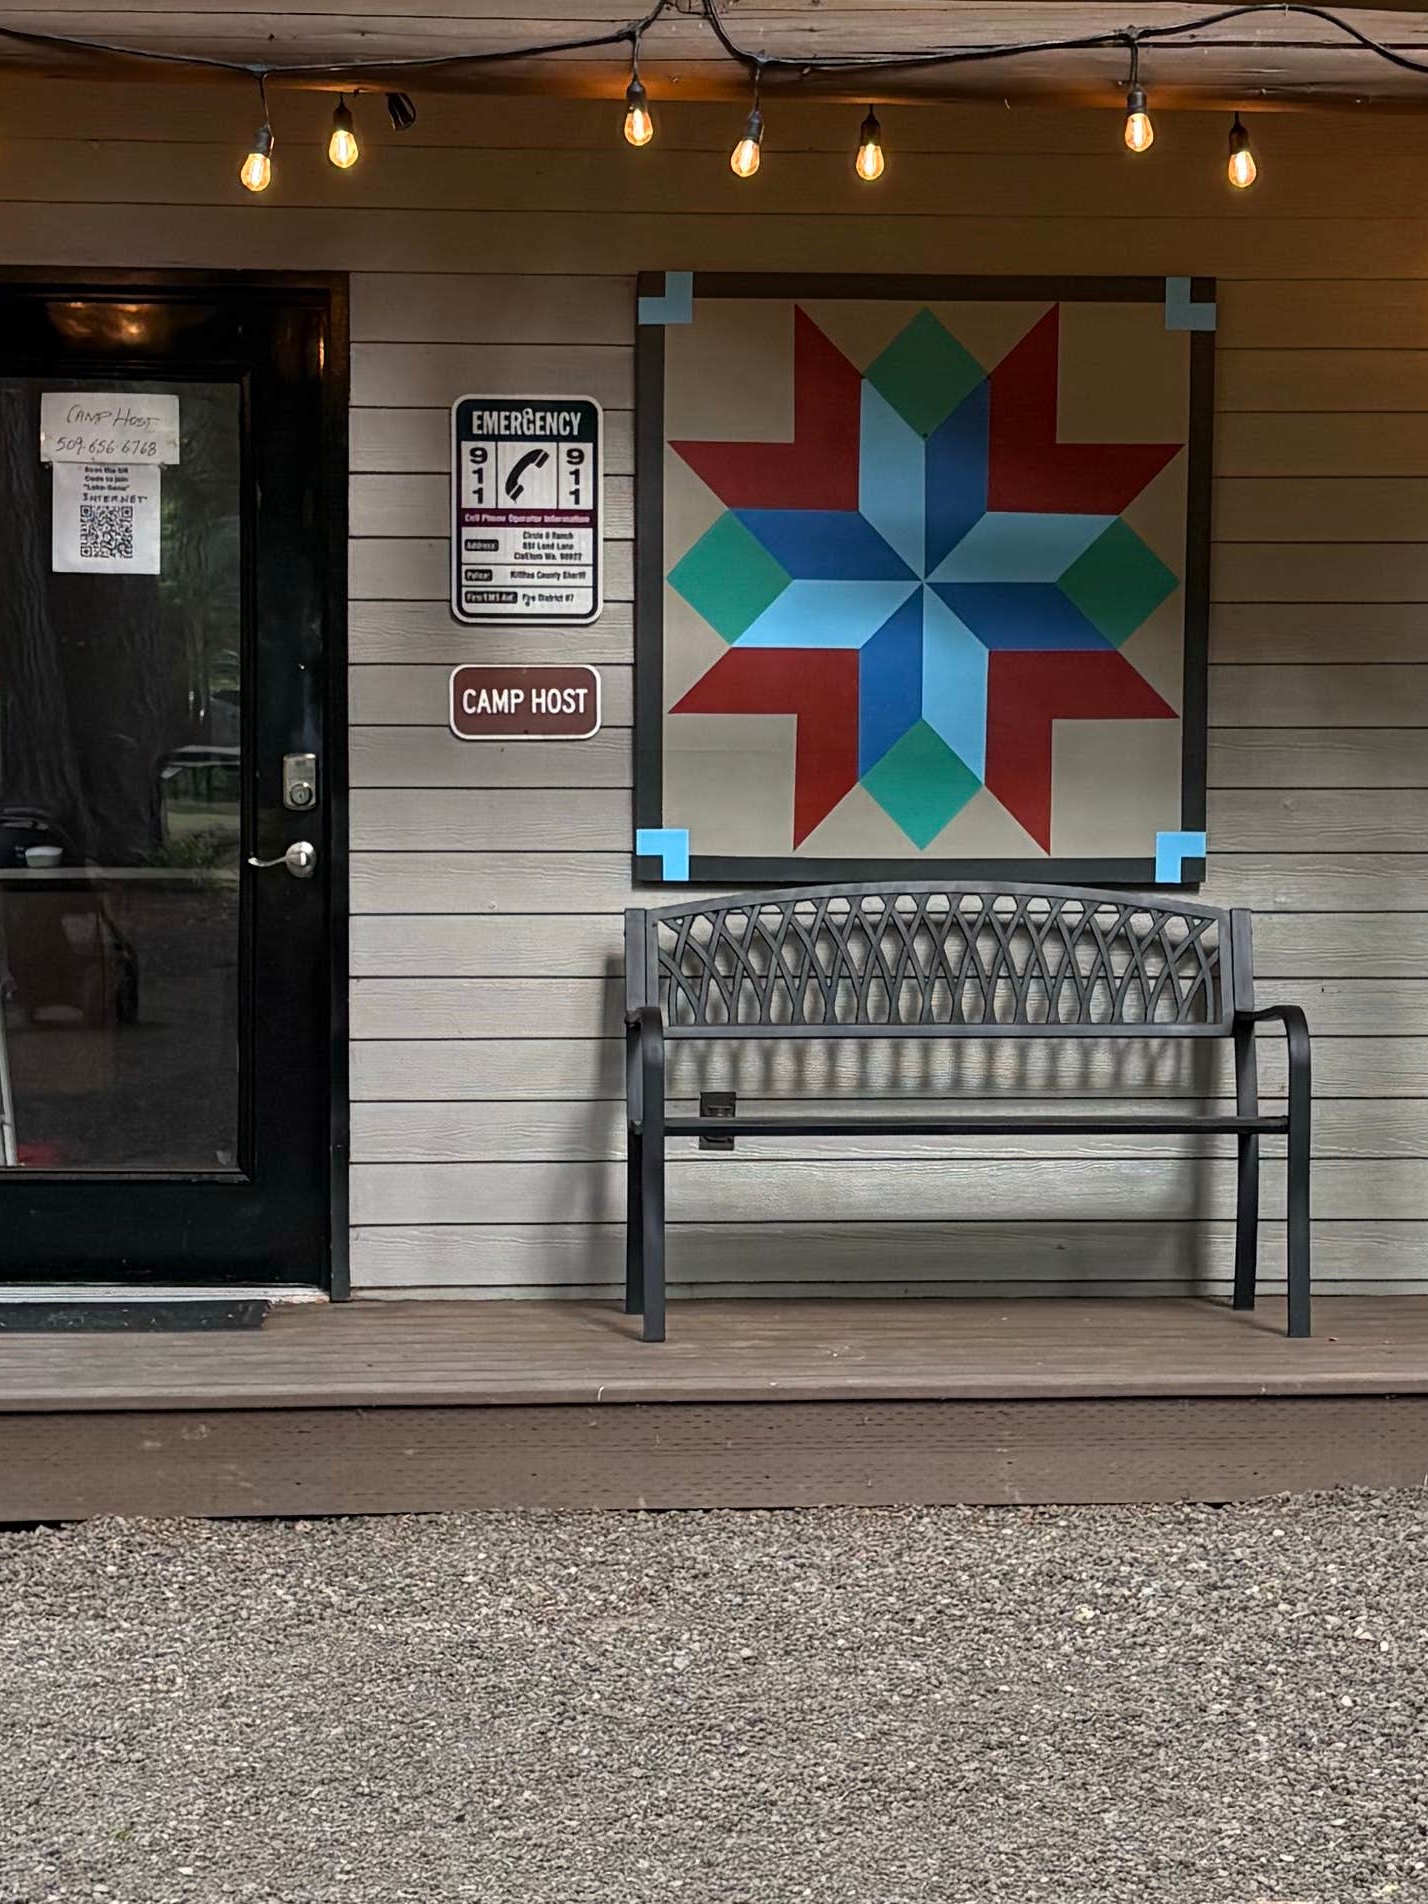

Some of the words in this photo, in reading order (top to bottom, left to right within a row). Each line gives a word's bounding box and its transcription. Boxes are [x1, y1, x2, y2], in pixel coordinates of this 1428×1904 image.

[472, 410, 581, 436] EMERGENCY
[83, 493, 148, 503] INTERNET
[465, 514, 480, 522] Cell
[481, 514, 506, 522] Phone
[462, 688, 524, 714] CAMP
[531, 688, 588, 714] HOST
